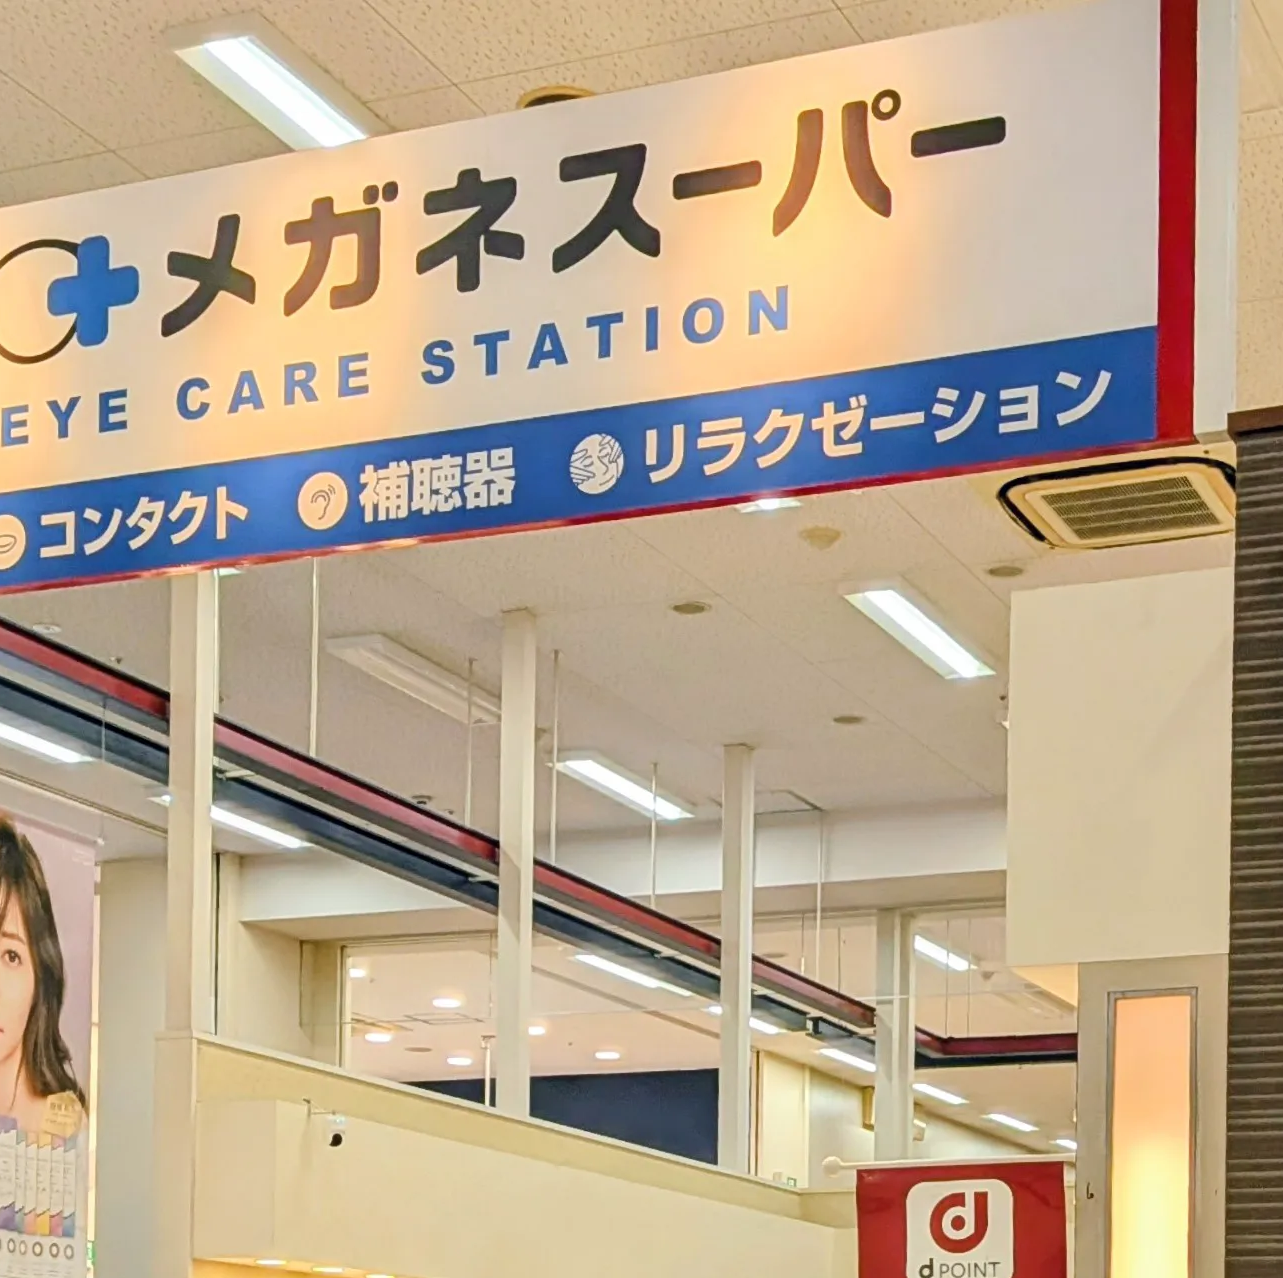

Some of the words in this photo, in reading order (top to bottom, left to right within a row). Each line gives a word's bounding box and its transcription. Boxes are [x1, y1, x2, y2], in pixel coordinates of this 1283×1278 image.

[158, 90, 1007, 339] メガネスーパー
[0, 387, 132, 448] EYE
[174, 353, 373, 421] CARE
[419, 286, 796, 387] STATION
[643, 365, 1112, 484] リラクゼーション
[38, 487, 250, 560] コンタクト
[358, 447, 517, 520] 補聴器
[939, 1261, 1000, 1278] POINT
